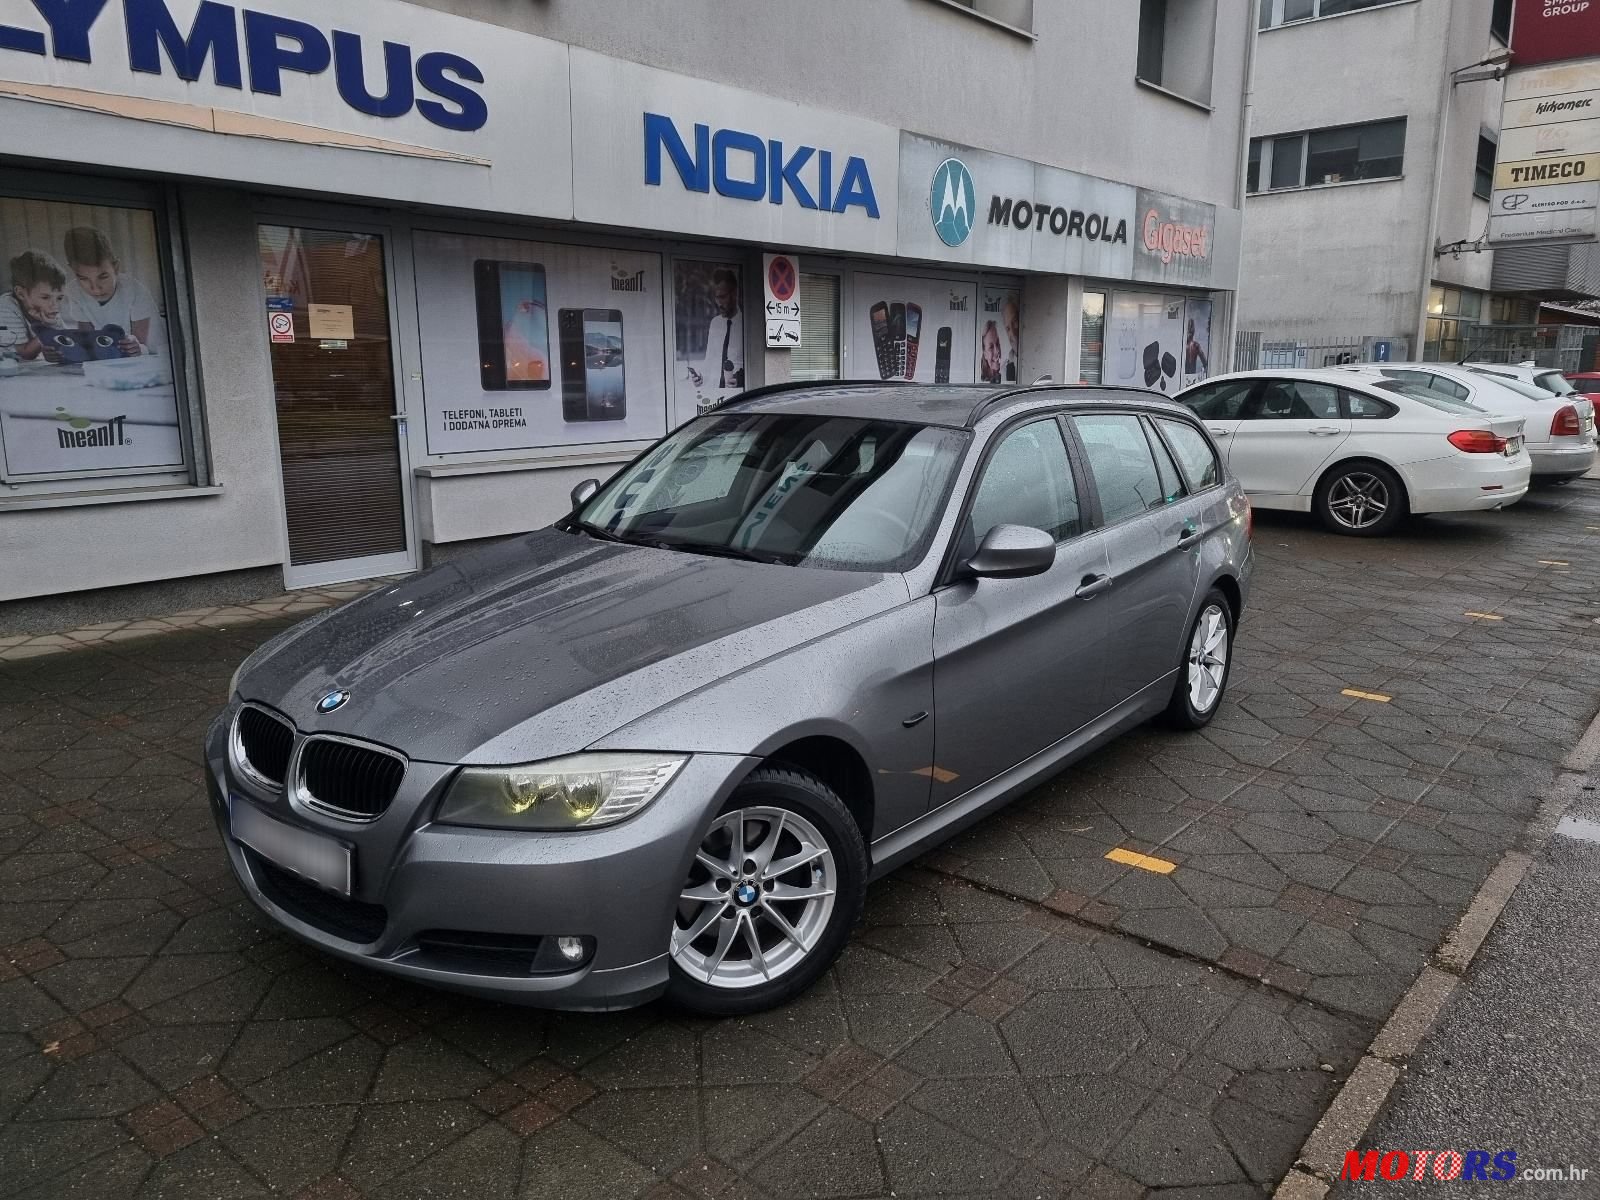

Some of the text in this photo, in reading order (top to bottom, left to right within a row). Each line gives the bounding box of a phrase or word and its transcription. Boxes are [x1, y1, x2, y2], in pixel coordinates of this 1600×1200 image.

[1543, 2, 1589, 17] GROUP
[643, 112, 880, 219] NOKIA
[1511, 161, 1585, 182] TIMECO
[987, 195, 1127, 244] MOTOROLA
[1143, 209, 1207, 264] Gigaset
[442, 408, 522, 420] TELEFONI, TABLETI
[443, 418, 527, 431] I DODATNA OPREMA
